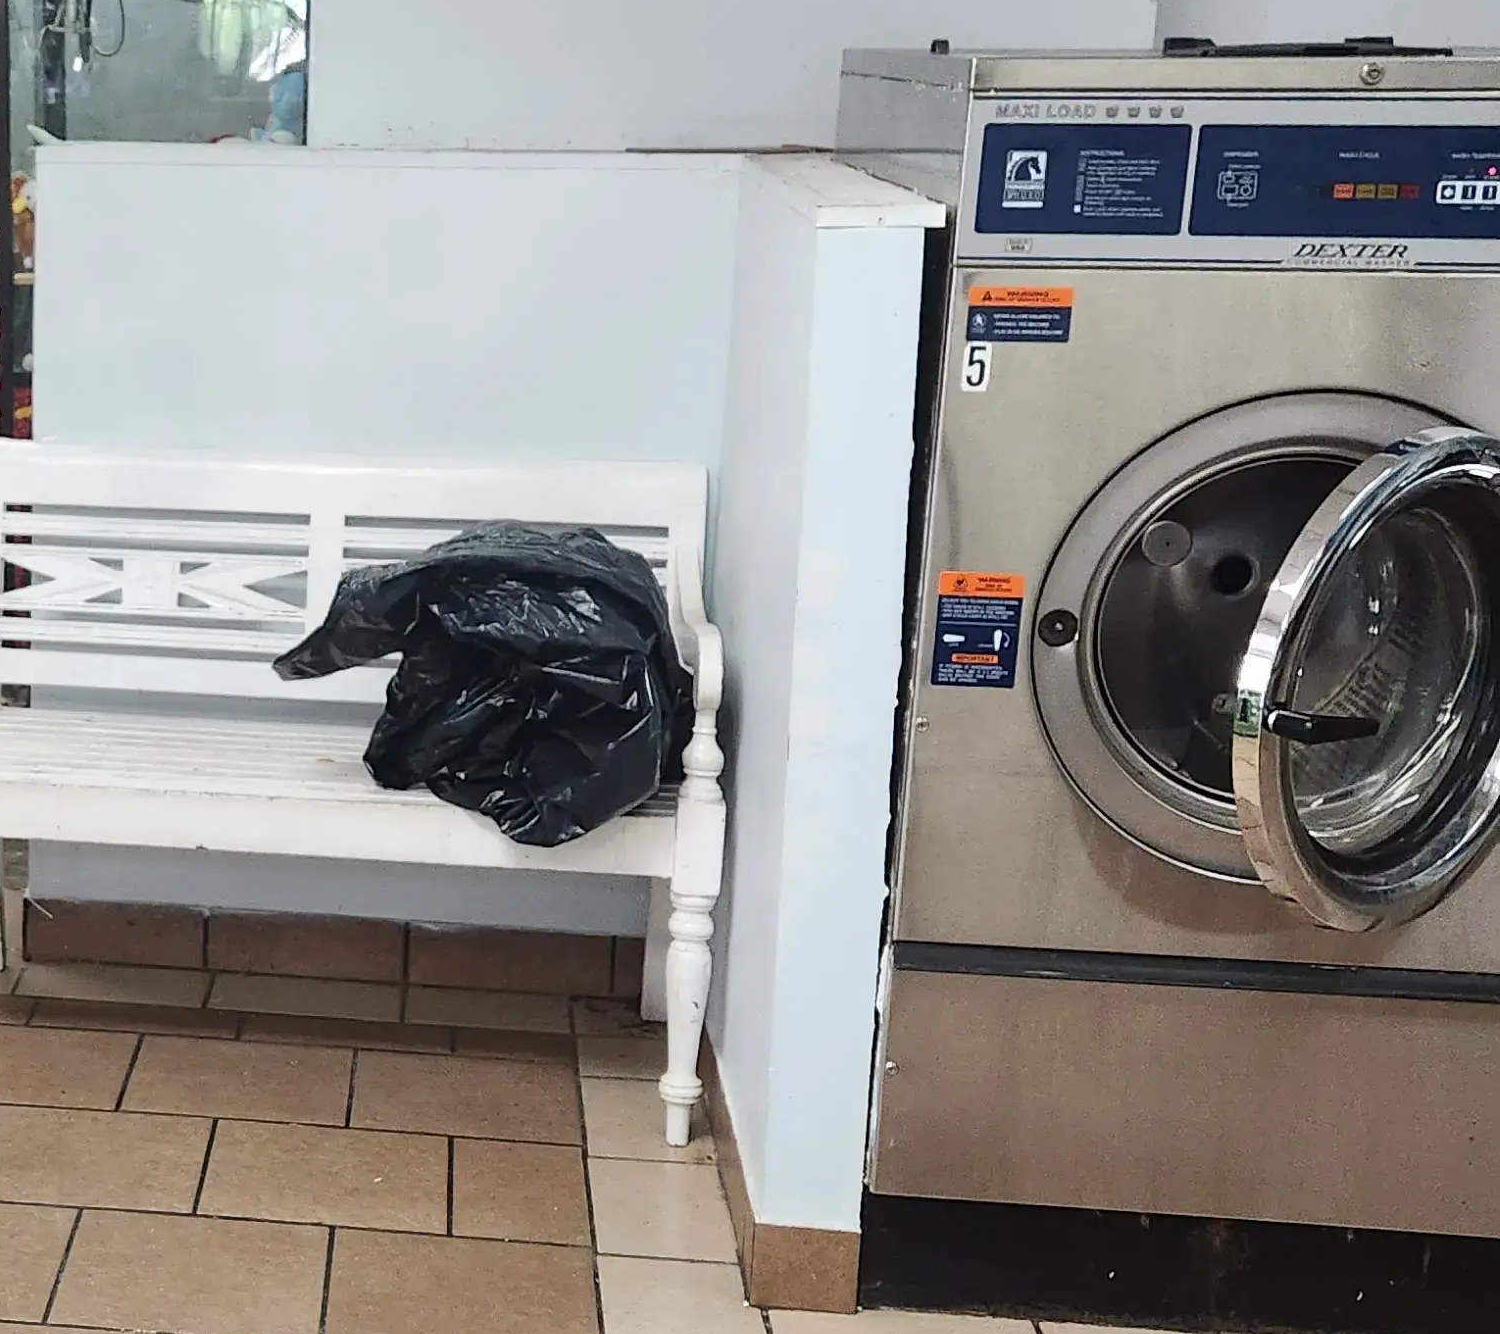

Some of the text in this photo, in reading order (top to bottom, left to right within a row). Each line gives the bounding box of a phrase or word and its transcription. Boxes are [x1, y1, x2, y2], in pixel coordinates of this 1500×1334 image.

[995, 104, 1097, 119] MAXI LOAD
[1293, 243, 1408, 259] DEXTER
[966, 346, 987, 387] 5
